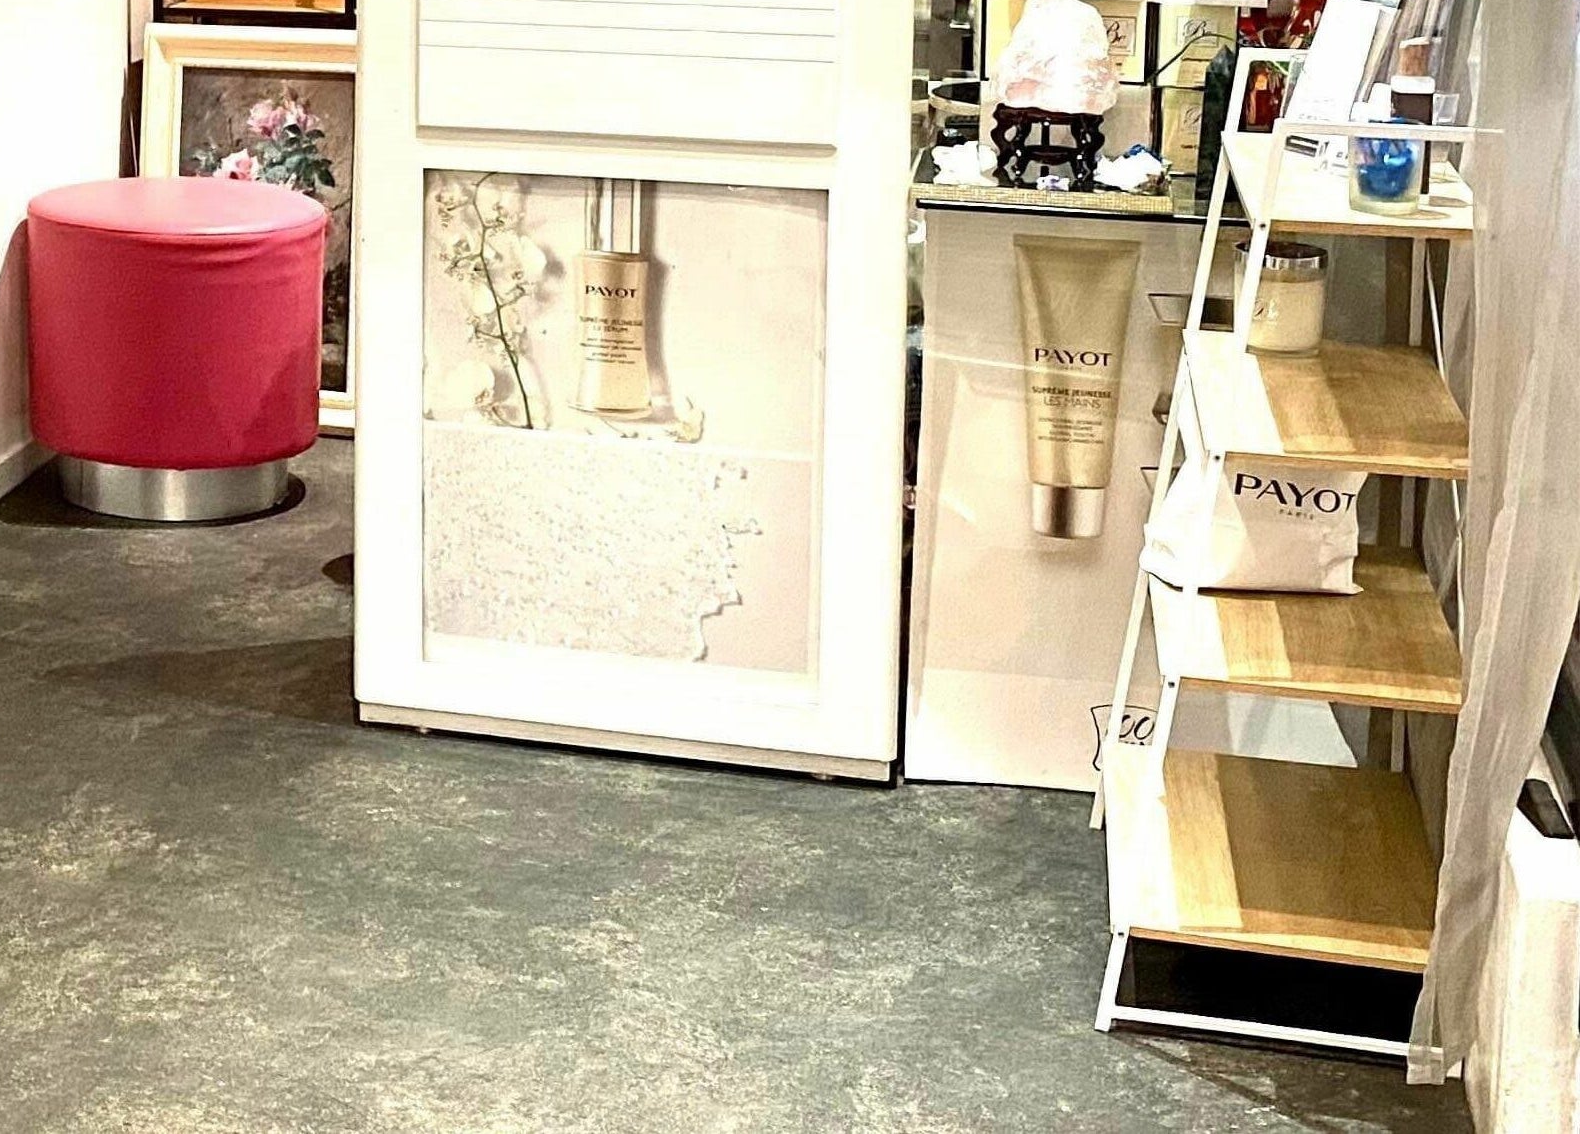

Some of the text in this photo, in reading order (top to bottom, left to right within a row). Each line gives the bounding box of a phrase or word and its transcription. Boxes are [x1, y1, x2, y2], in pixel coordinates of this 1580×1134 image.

[585, 285, 638, 298] PAYOT
[1034, 348, 1114, 367] PAYOT
[1234, 472, 1357, 514] PAYOT
